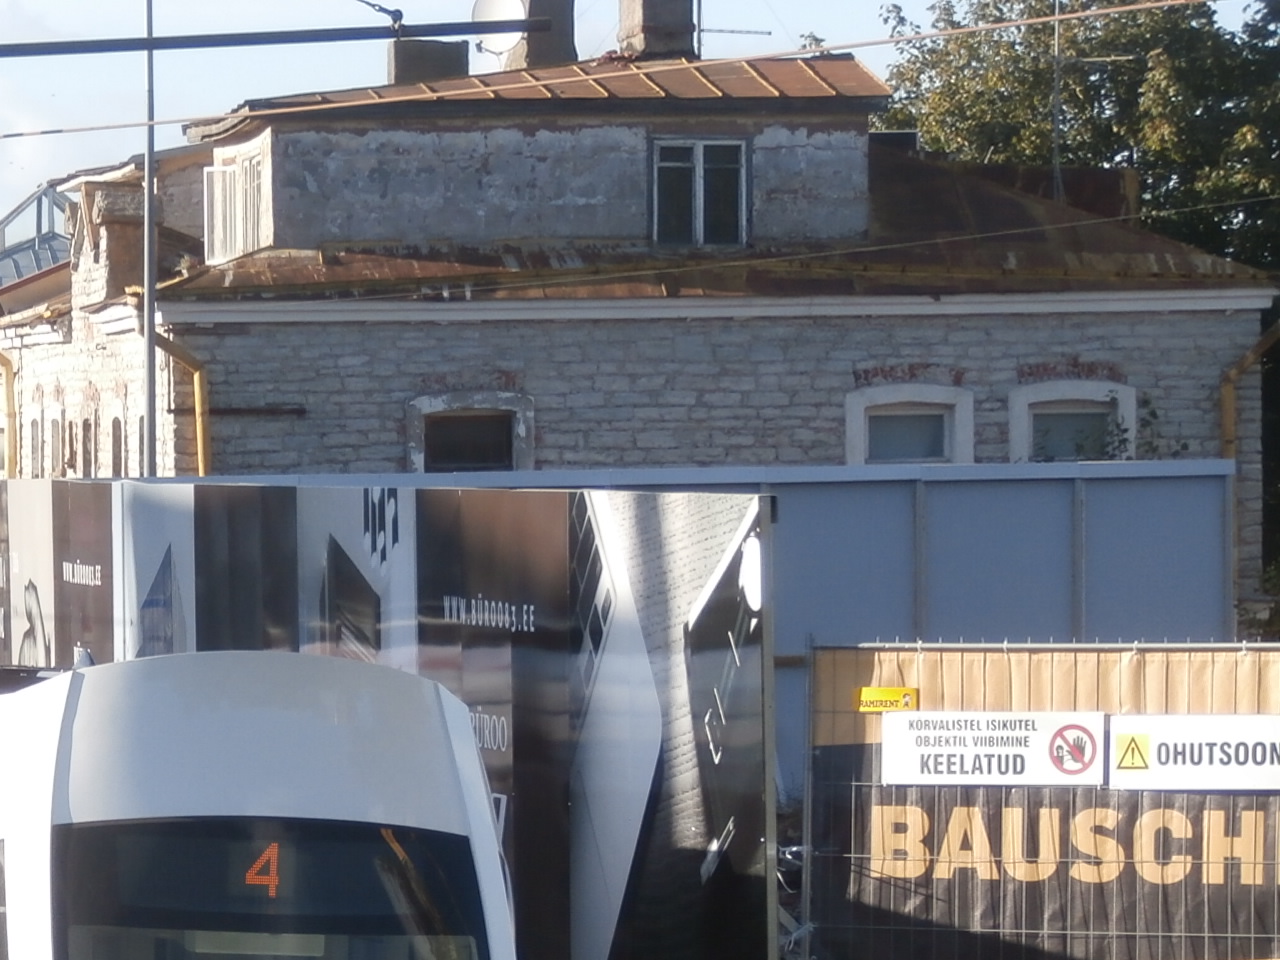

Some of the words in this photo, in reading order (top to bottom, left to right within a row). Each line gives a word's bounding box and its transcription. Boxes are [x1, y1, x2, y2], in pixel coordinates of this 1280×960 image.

[443, 594, 535, 633] WWW.BÜROO83.EE
[859, 699, 899, 708] RAMIRENT
[986, 719, 1038, 731] ISIKUTEL
[915, 736, 968, 748] OBJEKTIL
[972, 736, 1030, 748] VIIBIMINE
[920, 753, 1026, 775] KEELATUD
[870, 805, 1280, 885] BAUSCH
[245, 842, 280, 898] 4
